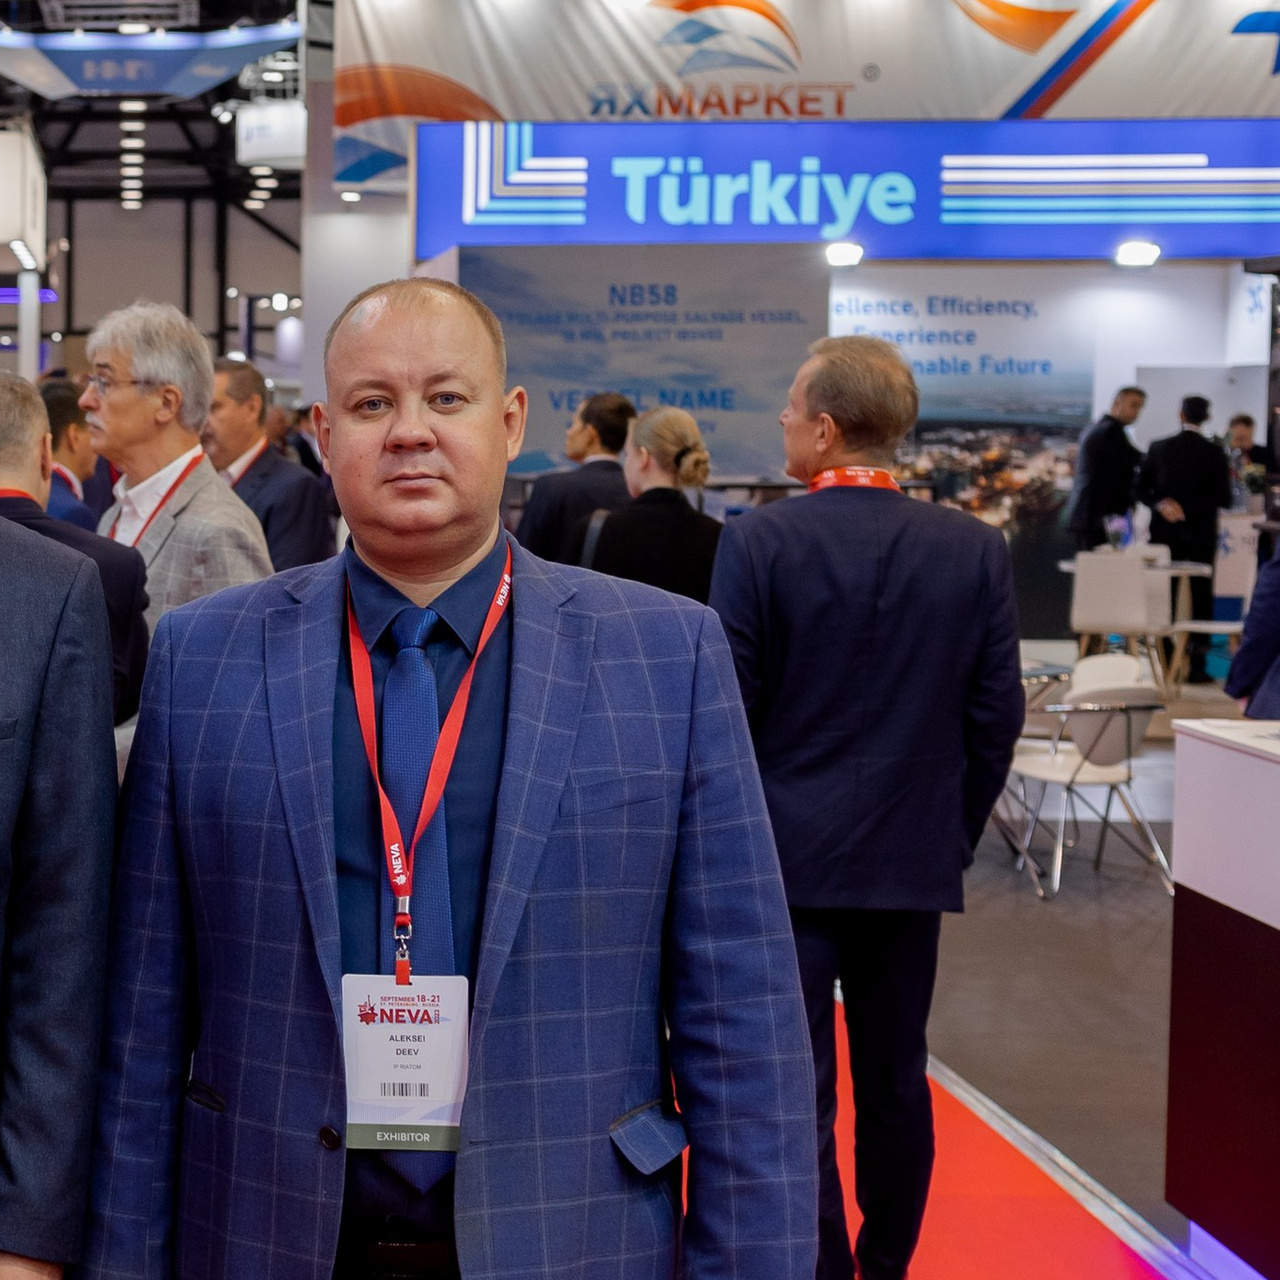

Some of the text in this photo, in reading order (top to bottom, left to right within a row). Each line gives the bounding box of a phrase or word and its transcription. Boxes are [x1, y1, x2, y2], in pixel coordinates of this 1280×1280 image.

[589, 81, 856, 118] ЯХМАРКЕТ
[611, 156, 917, 241] Türkiye
[608, 283, 678, 306] NB58
[926, 295, 1039, 321] Efficiency,
[978, 354, 1054, 375] Future
[657, 388, 736, 411] NAME
[390, 842, 404, 874] NEVA
[380, 1008, 433, 1024] NEVA
[395, 1048, 420, 1056] DEEV
[376, 1131, 431, 1143] EXHIBITOR
